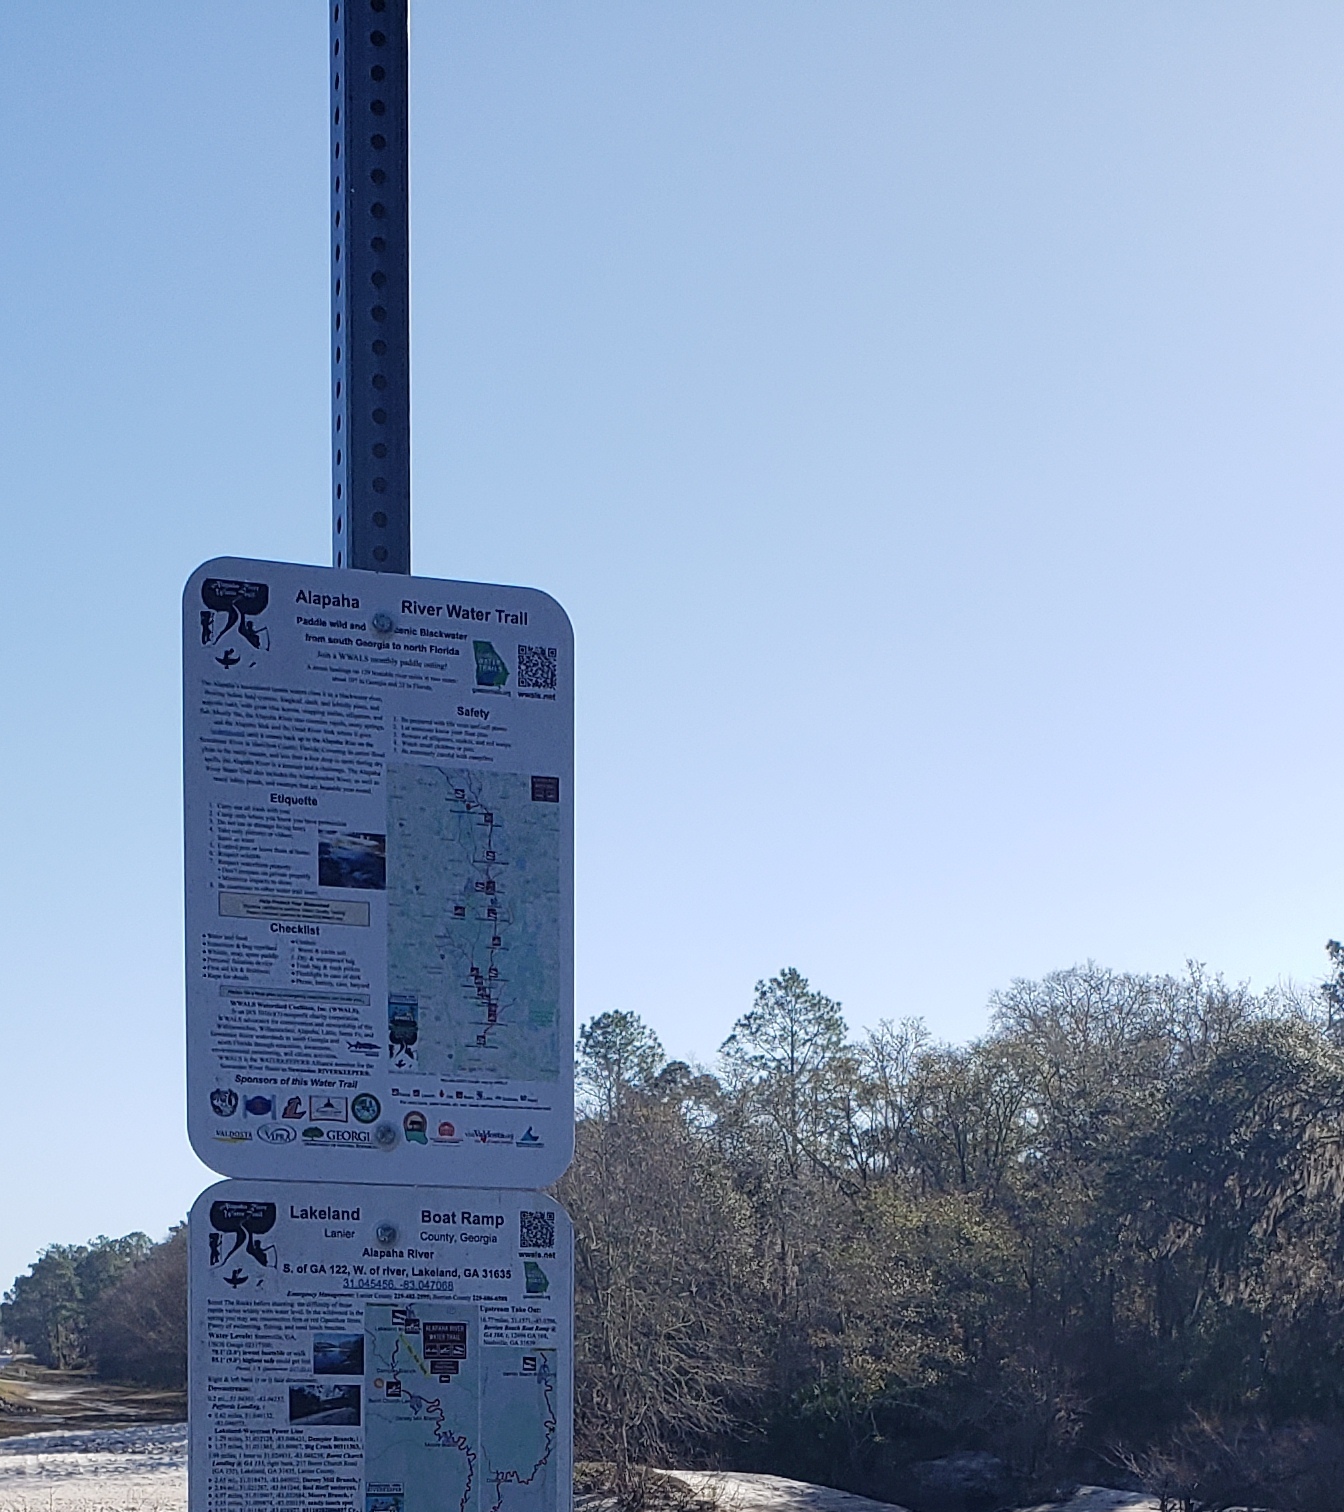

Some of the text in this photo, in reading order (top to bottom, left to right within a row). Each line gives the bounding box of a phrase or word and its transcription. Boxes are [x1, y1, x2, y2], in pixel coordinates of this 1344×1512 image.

[296, 590, 528, 626] Alapaha River Water Trail
[296, 616, 327, 627] Paddle
[330, 619, 348, 629] wild
[349, 621, 366, 631] and
[419, 628, 468, 641] Blackwater
[305, 633, 460, 656] from south Georgia to north Florida
[457, 706, 490, 720] Safety
[270, 793, 318, 806] Etiquette
[270, 922, 321, 936] Checklist
[235, 1075, 358, 1089] Sponsors of this Water Trail
[326, 1130, 370, 1142] GEORGI
[290, 1205, 505, 1228] Lakeland Boat Ramp
[324, 1228, 498, 1245] Lanier County, Georgia
[362, 1247, 434, 1259] Alapaha River
[283, 1263, 512, 1279] S. of GA 122, W. of river, Lakeland, GA 31635
